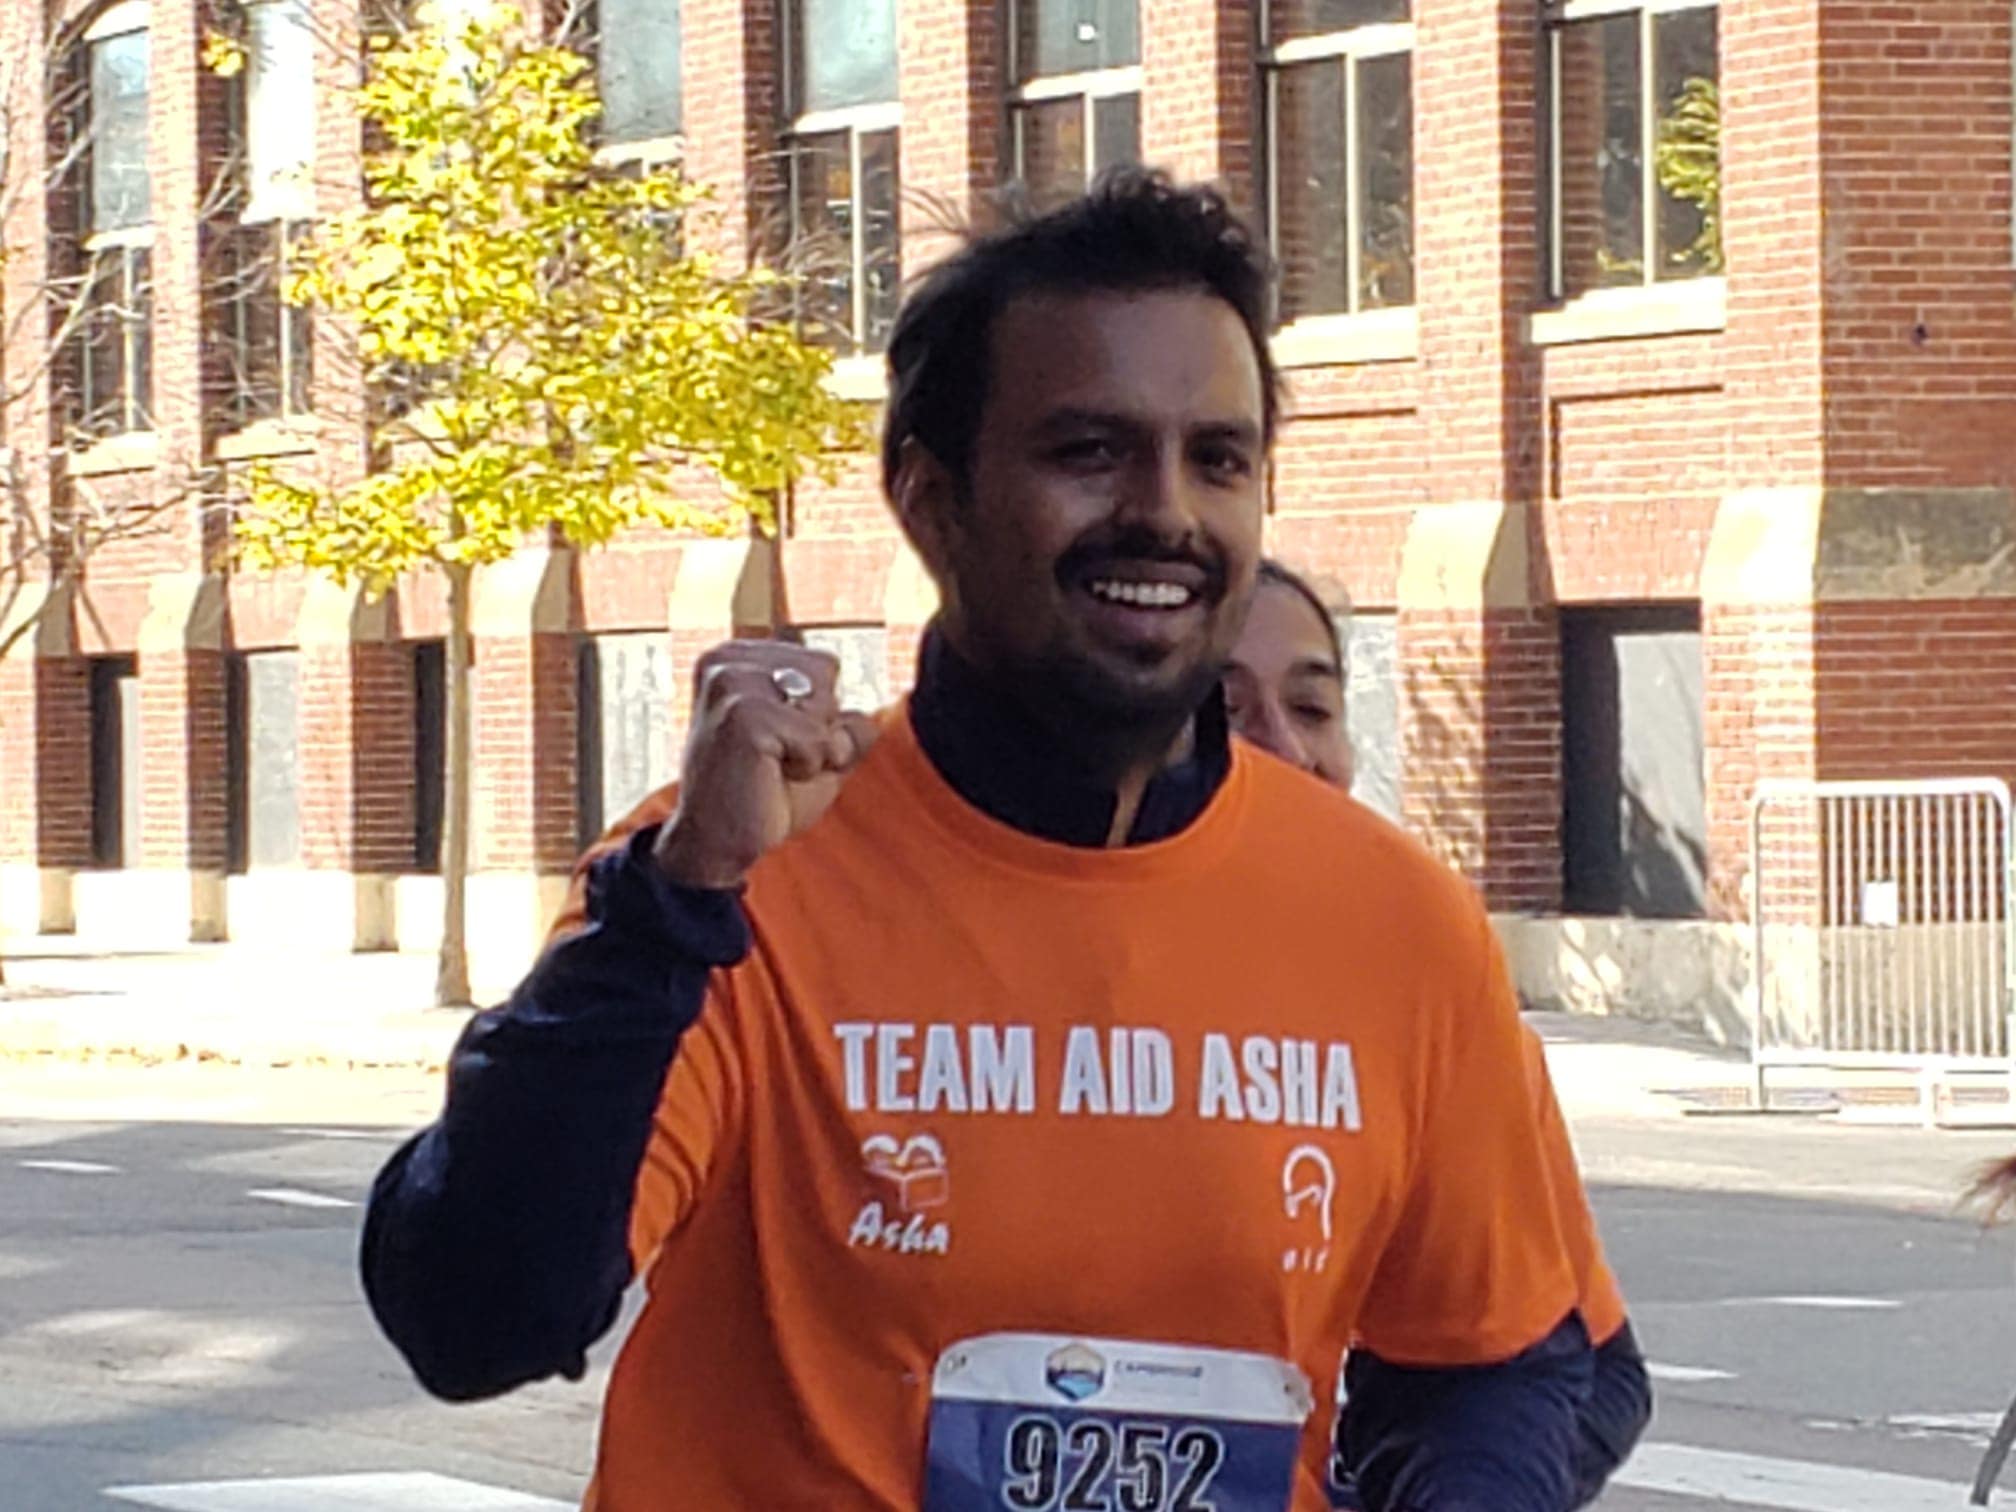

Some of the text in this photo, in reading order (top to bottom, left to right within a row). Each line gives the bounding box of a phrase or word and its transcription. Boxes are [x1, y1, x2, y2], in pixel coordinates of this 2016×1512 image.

[834, 1022, 1362, 1131] TEAM AID ASHA
[848, 1200, 949, 1254] Asha
[1003, 1413, 1224, 1512] 9252
